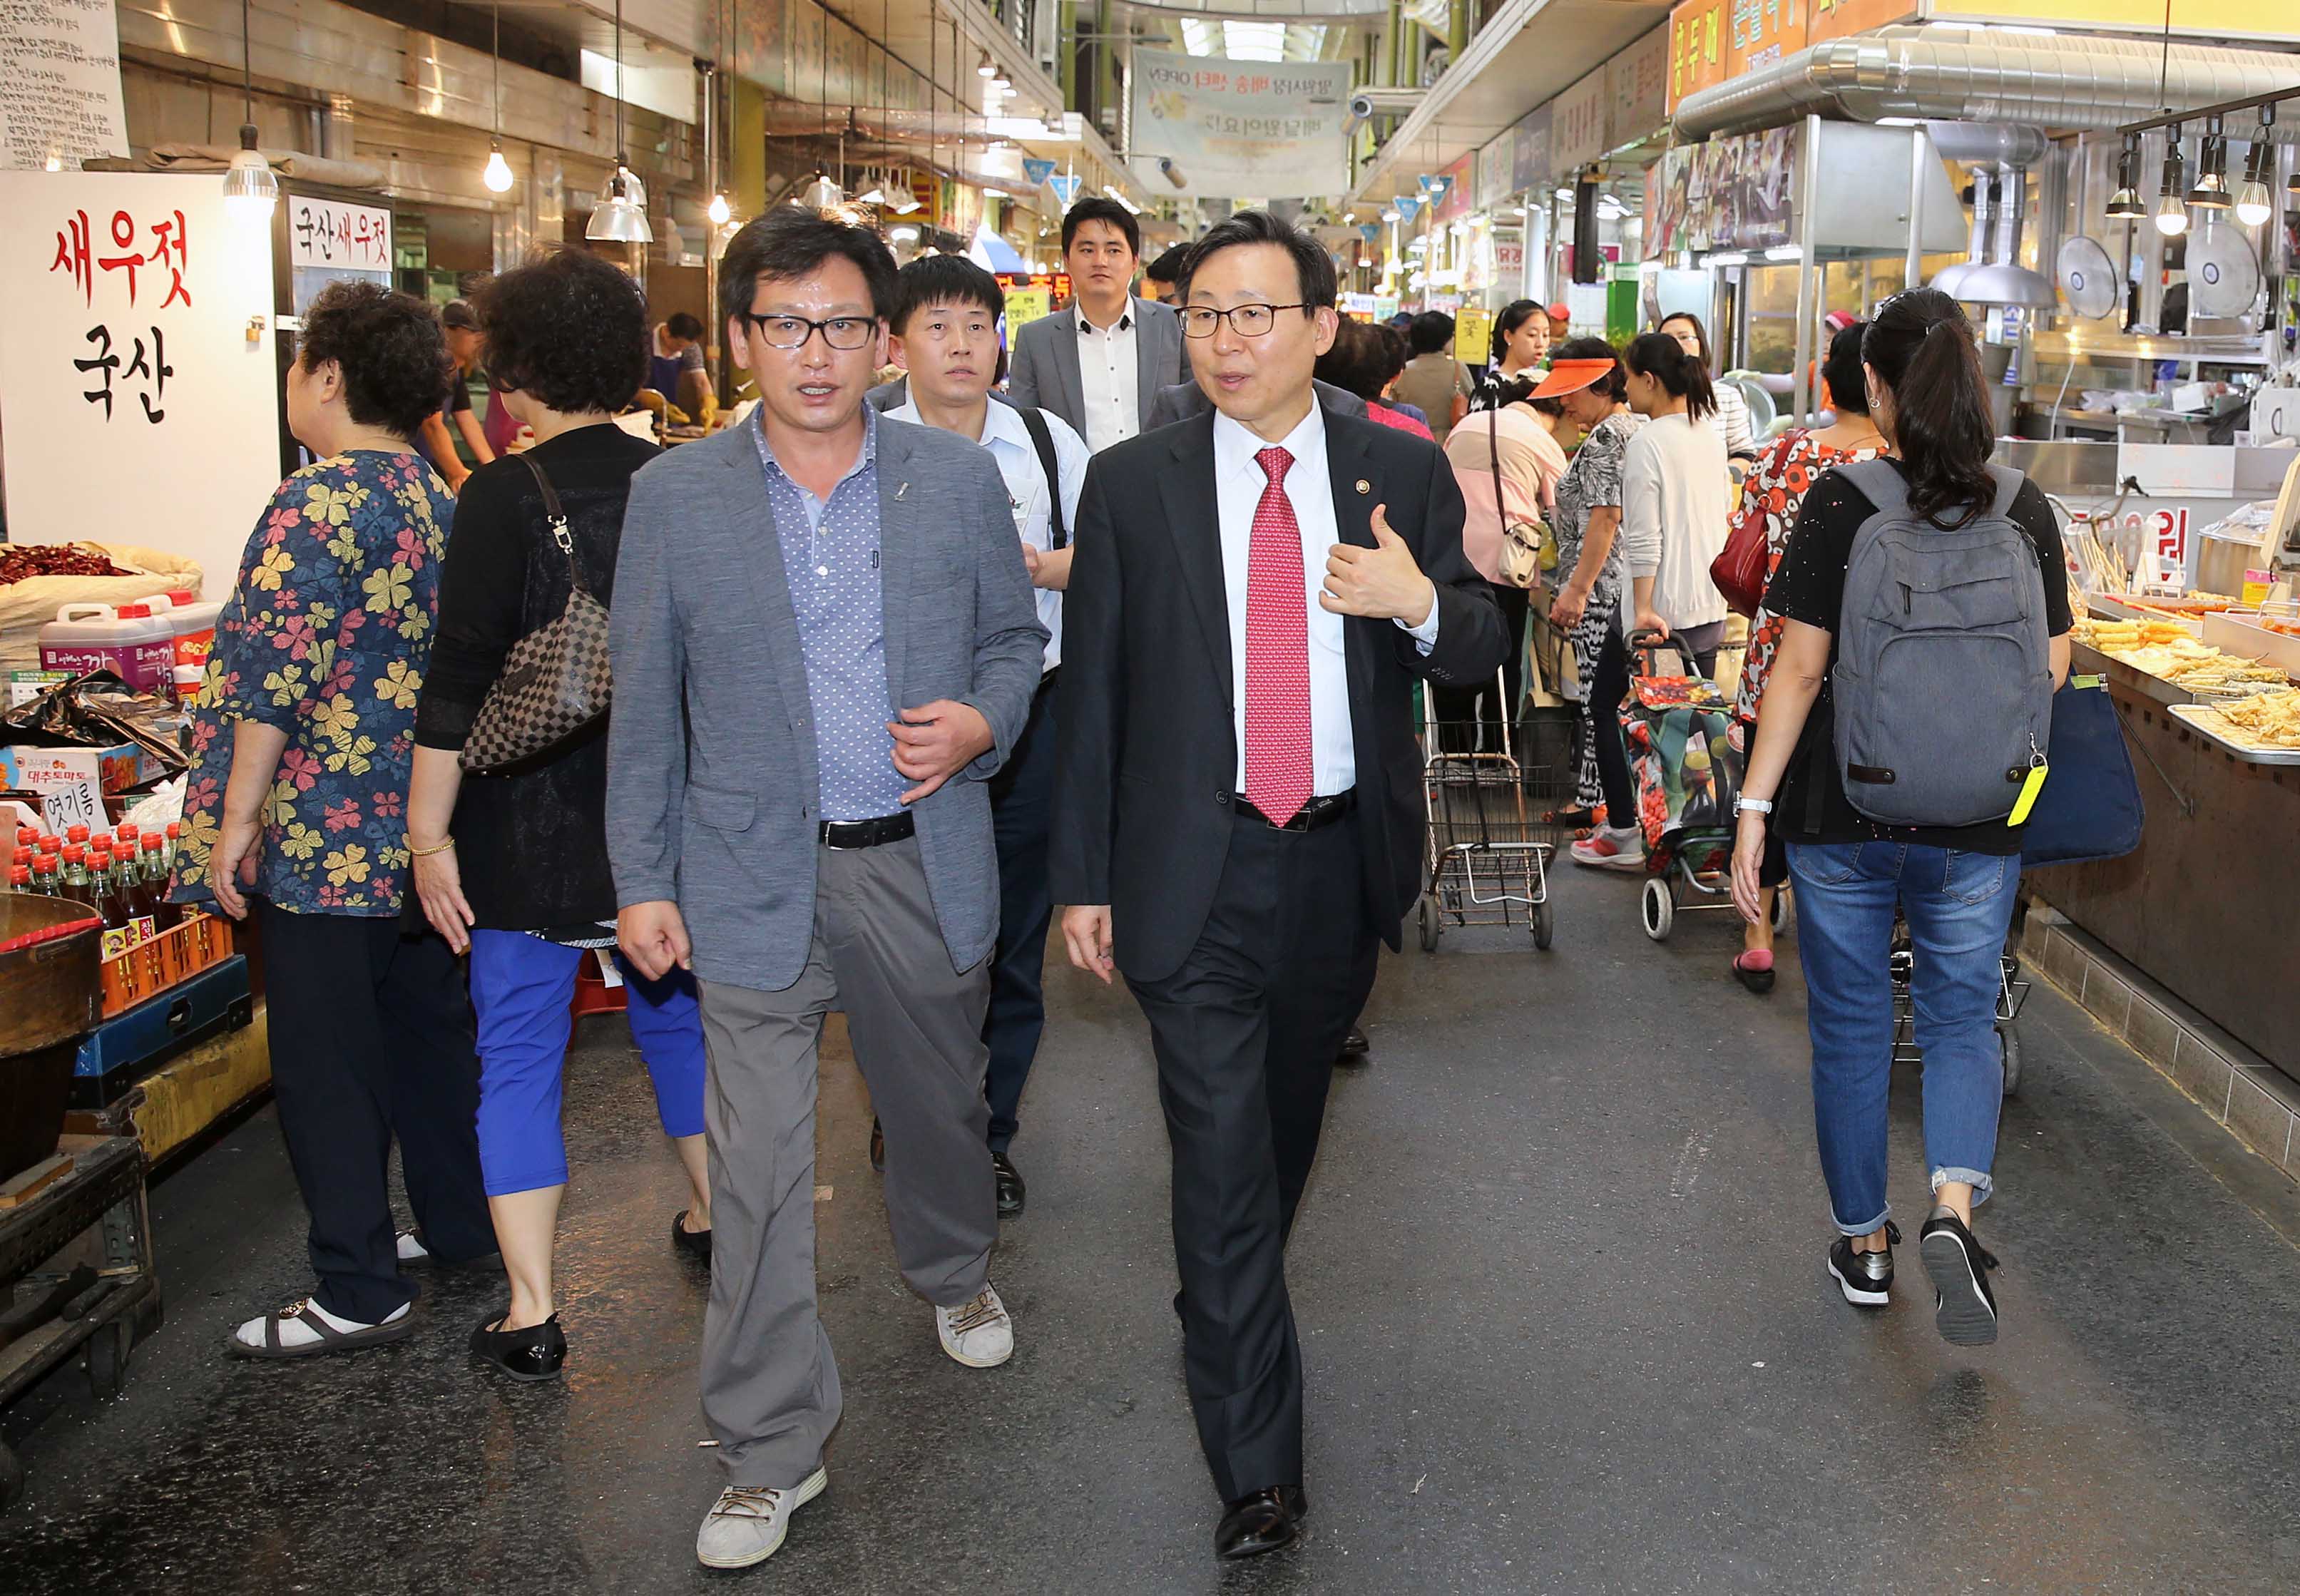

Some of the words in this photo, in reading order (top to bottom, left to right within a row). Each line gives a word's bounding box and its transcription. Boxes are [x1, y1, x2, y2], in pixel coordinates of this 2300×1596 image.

[1674, 5, 1719, 98] 홍두깨
[49, 209, 191, 310] 새우젓
[73, 324, 173, 424] 국산
[27, 770, 86, 784] 대추토마토
[47, 782, 93, 828] 엿기름
